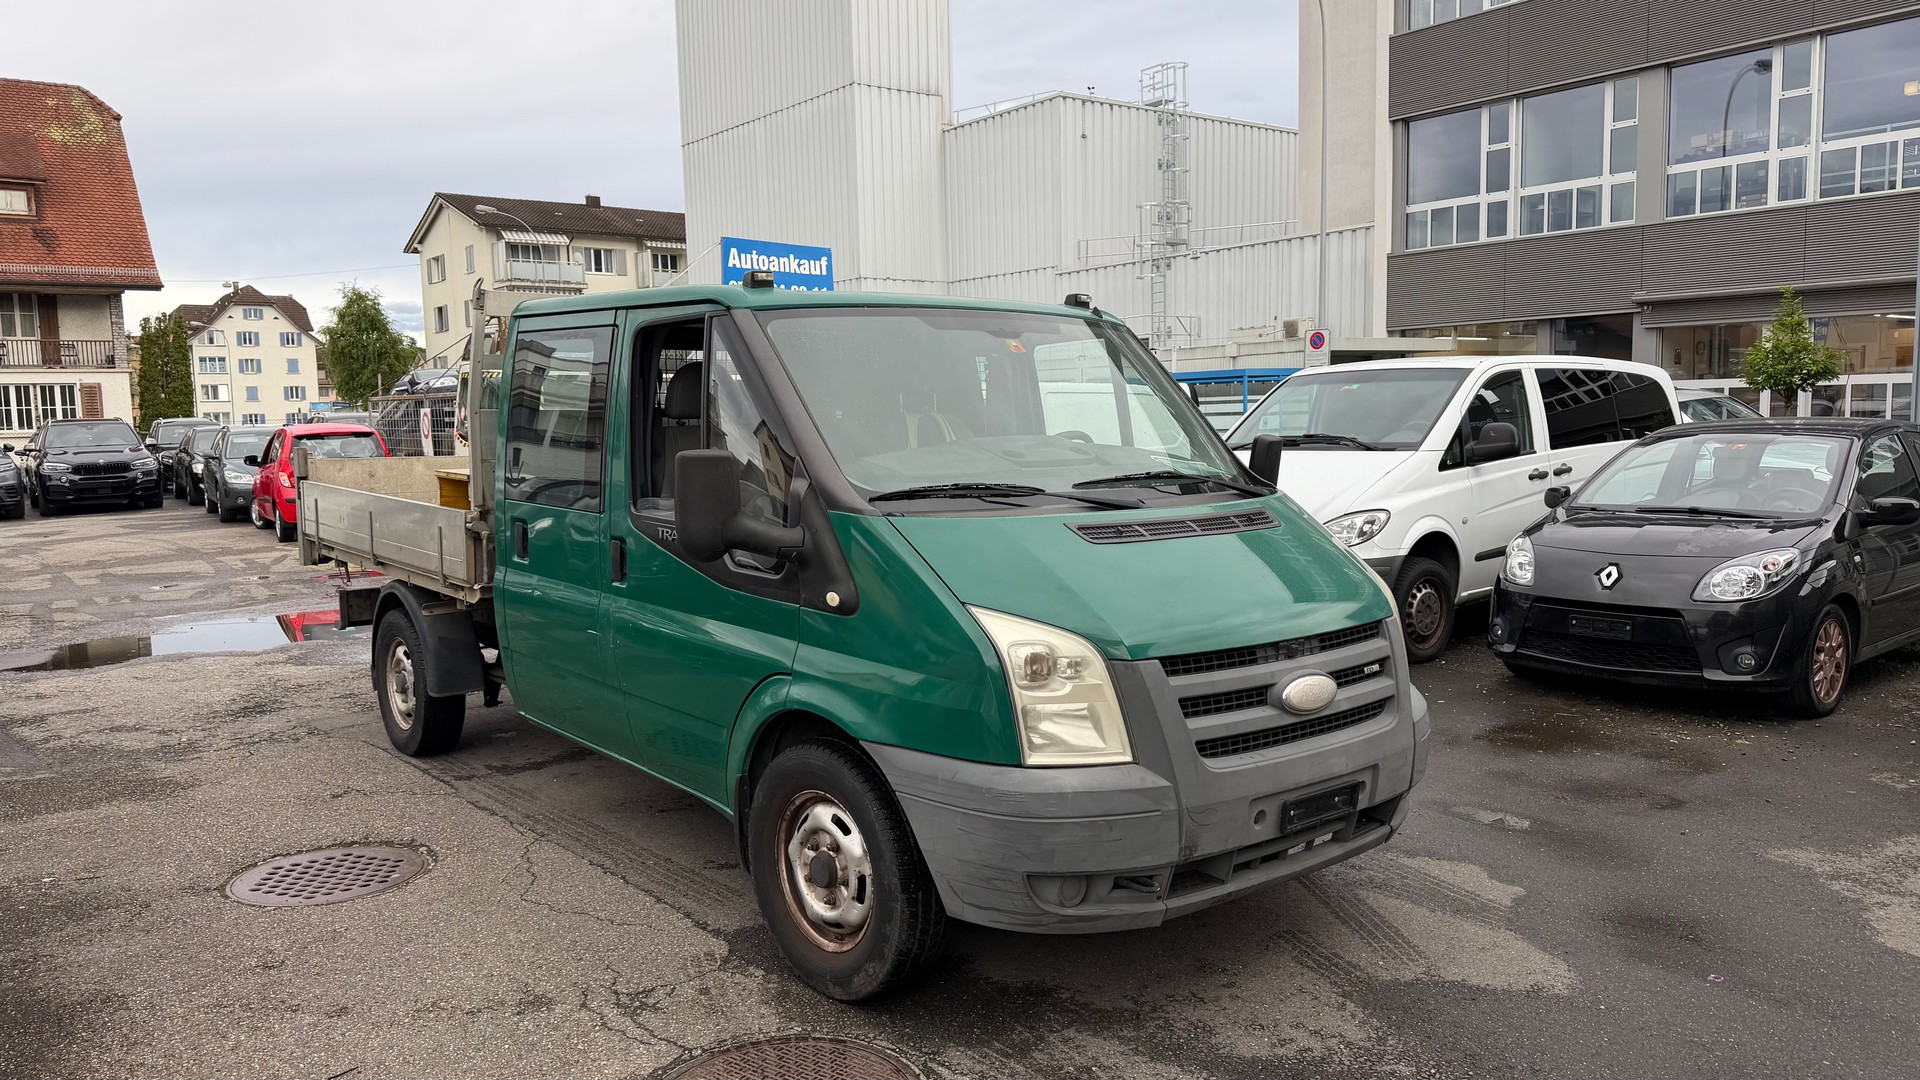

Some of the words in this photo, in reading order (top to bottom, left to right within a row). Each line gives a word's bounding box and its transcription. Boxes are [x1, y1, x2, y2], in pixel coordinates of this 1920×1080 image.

[728, 247, 828, 276] Autoankauf
[657, 527, 678, 541] TRA
[1301, 682, 1330, 702] Ford
